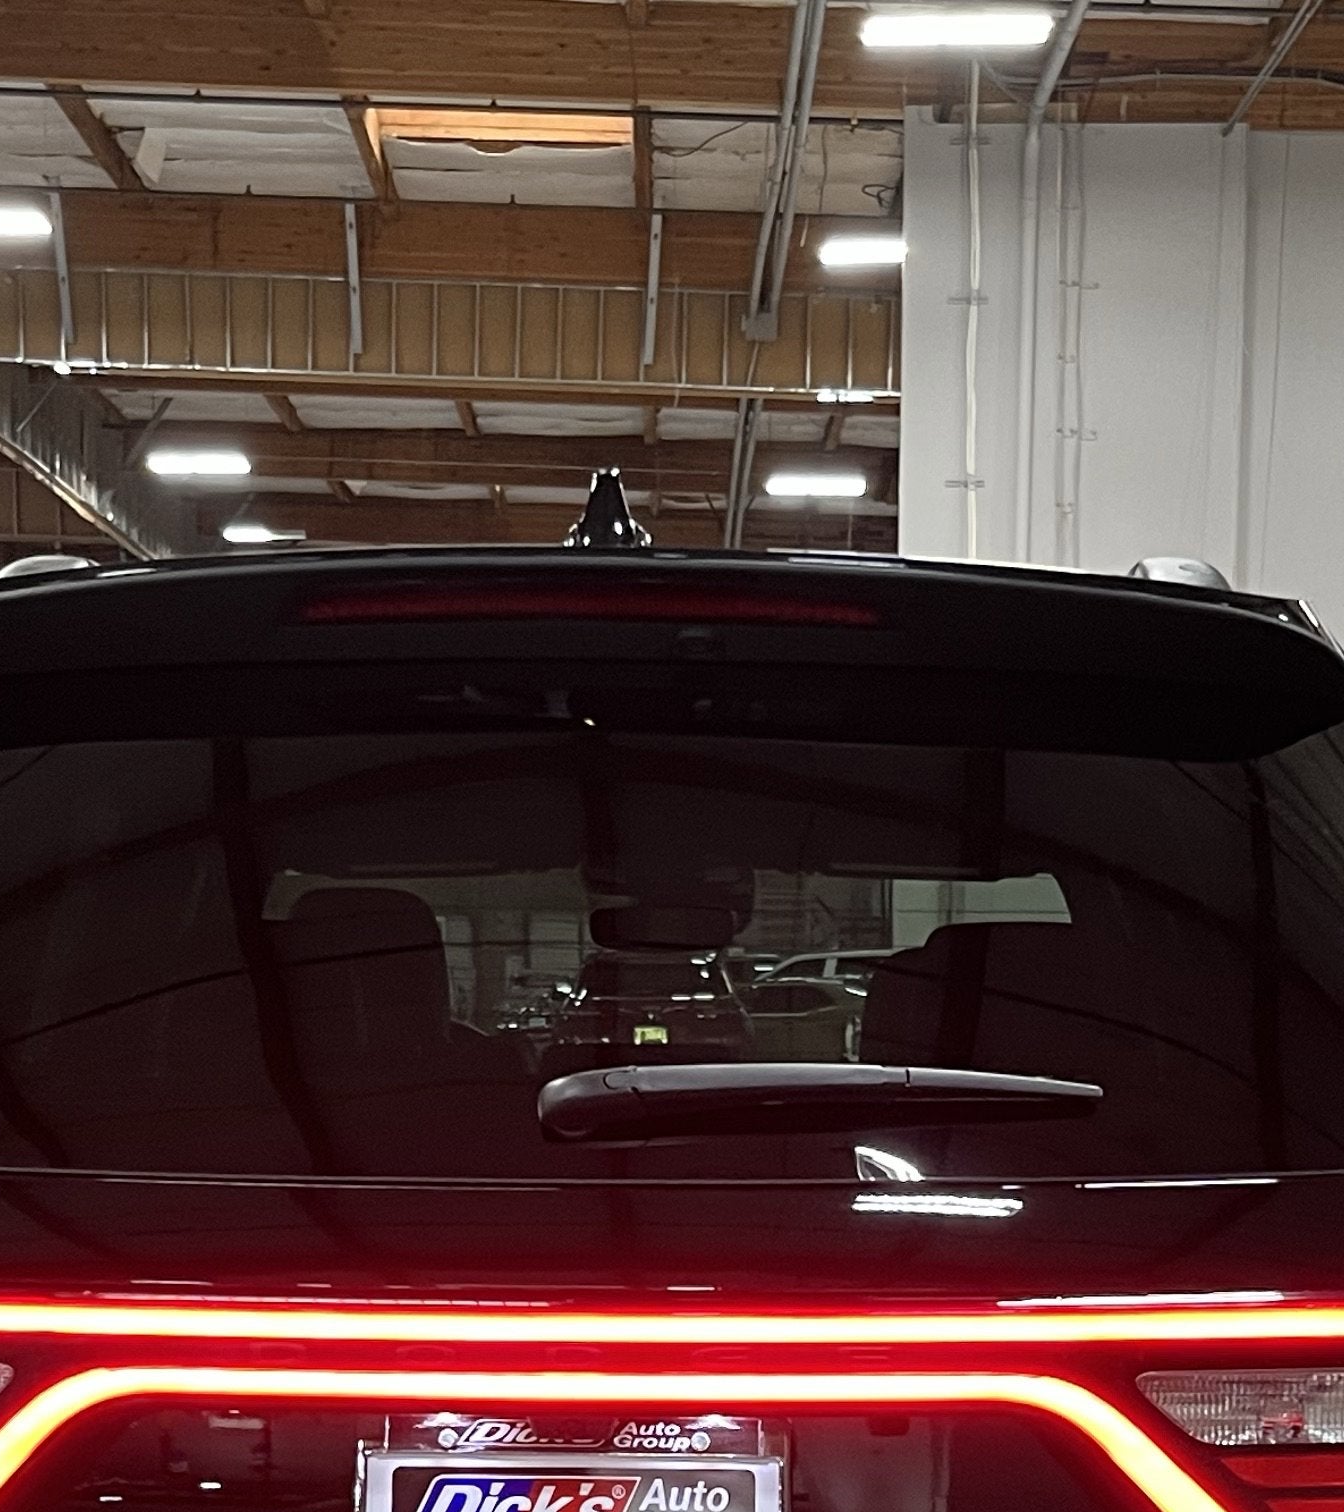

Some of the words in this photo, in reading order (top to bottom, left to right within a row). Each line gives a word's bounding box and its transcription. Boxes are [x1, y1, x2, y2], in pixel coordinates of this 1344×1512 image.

[620, 1421, 681, 1437] Auto
[613, 1434, 691, 1452] Group
[639, 1478, 730, 1512] Auto
